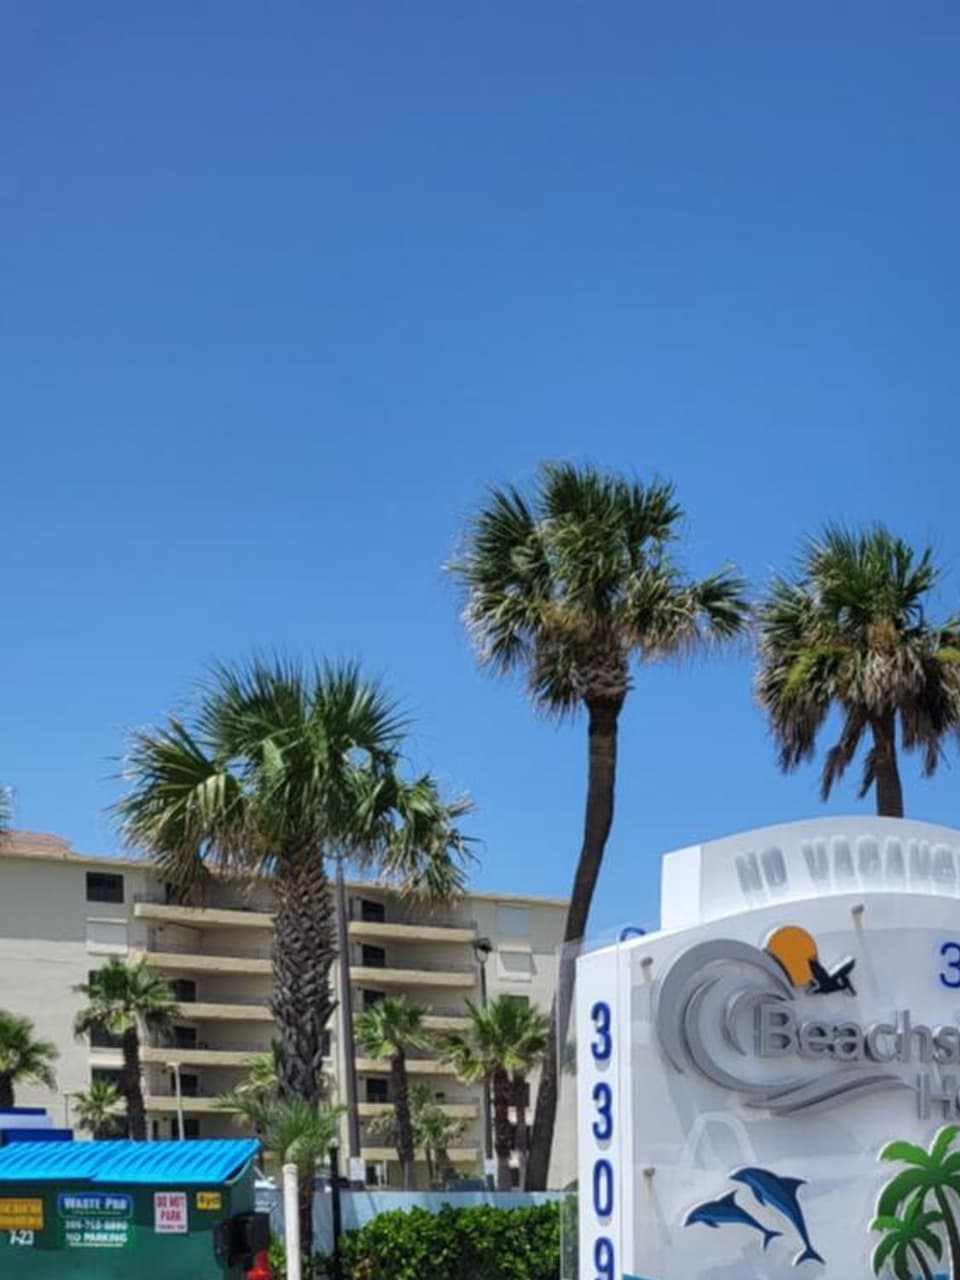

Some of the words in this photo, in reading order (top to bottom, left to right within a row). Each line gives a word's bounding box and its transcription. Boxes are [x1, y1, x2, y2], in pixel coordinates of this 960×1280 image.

[160, 1210, 182, 1221] PARK
[65, 1232, 82, 1242] NO
[83, 1232, 128, 1243] PARKING
